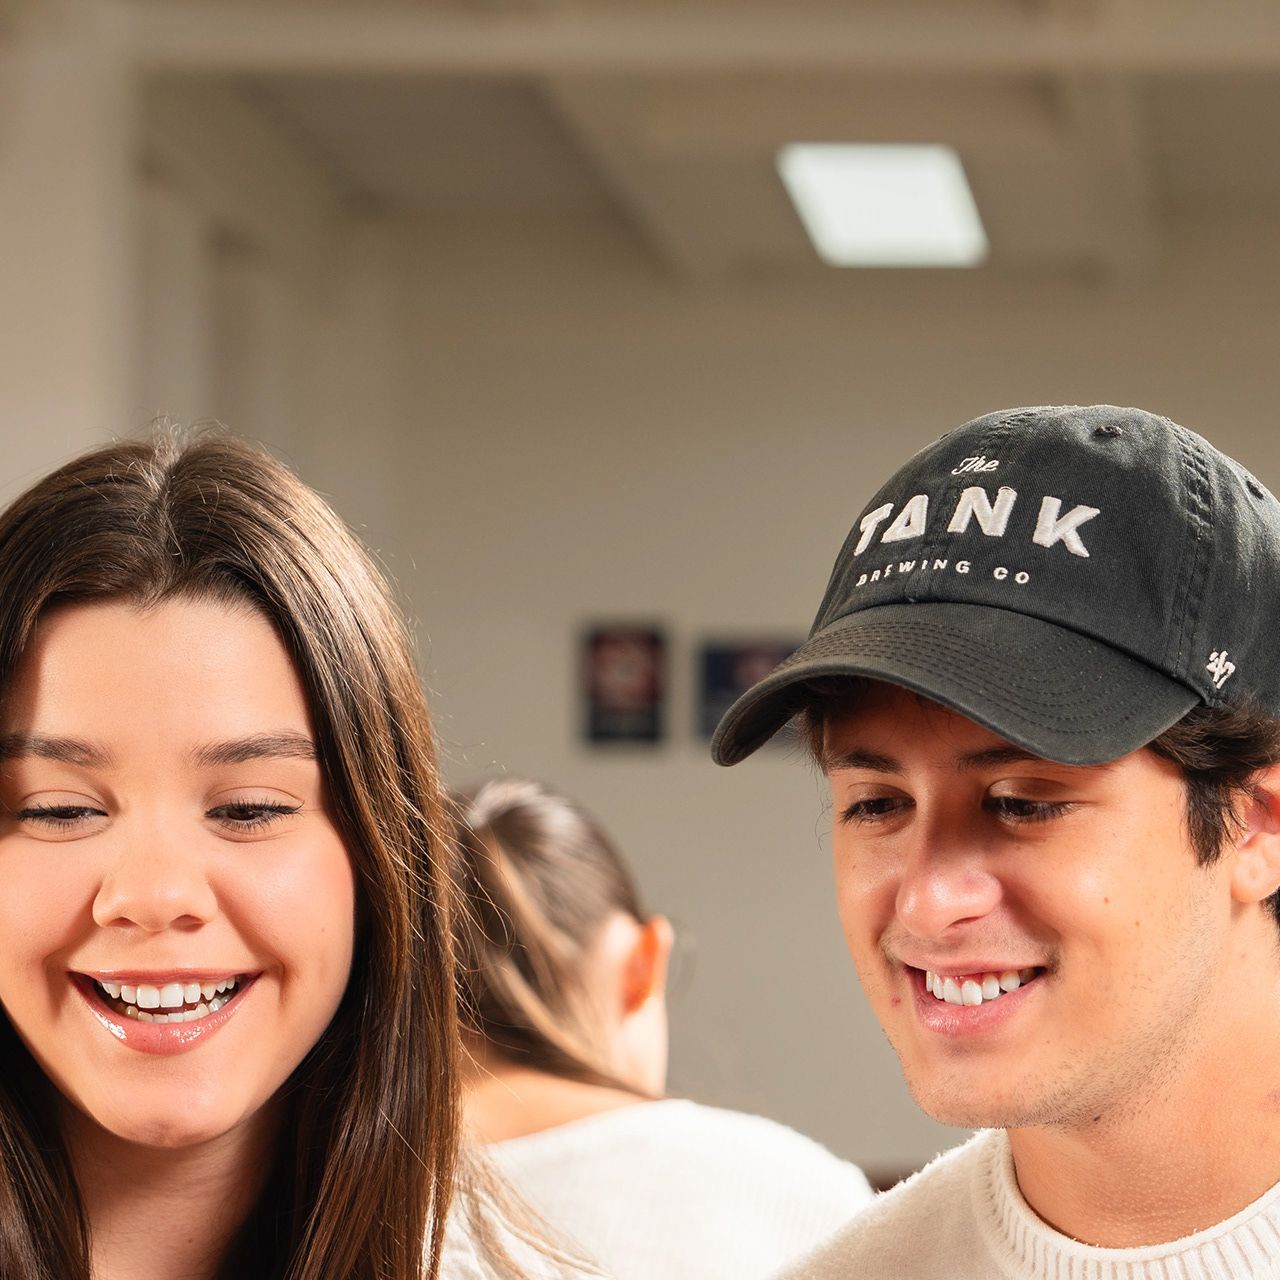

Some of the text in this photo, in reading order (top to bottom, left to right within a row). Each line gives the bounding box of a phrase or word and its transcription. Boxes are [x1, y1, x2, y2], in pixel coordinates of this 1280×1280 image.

[951, 455, 1000, 476] The
[853, 486, 1101, 558] TANK
[856, 558, 1030, 587] BREWING CO
